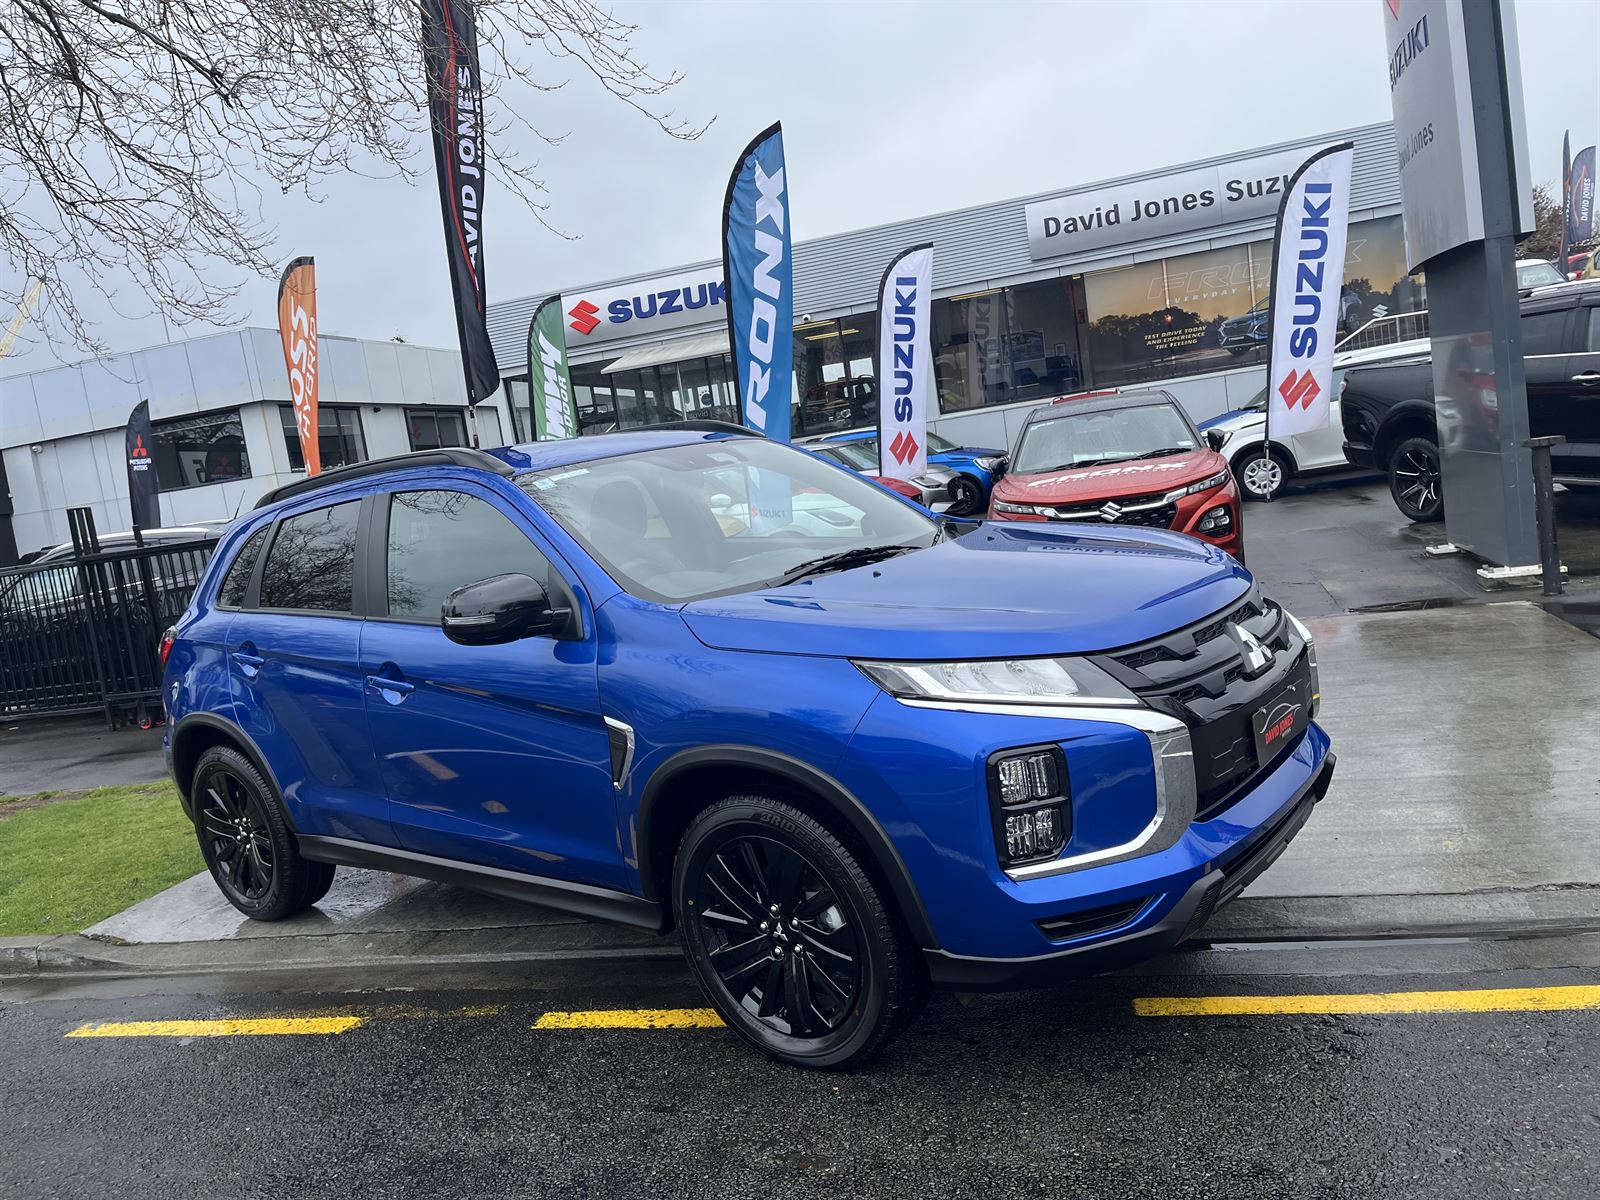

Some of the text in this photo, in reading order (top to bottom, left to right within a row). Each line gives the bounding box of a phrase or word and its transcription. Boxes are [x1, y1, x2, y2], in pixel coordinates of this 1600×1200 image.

[1411, 122, 1434, 158] Jones
[457, 66, 480, 290] AVID JONES
[1580, 177, 1592, 221] DAVID JONES
[1043, 174, 1290, 239] David Jones Suz
[1289, 182, 1333, 359] SUZUKI
[607, 280, 727, 324] SUZUK
[744, 159, 785, 431] RONX
[893, 276, 918, 423] SUZUKI
[1161, 329, 1183, 337] DRIVE
[1184, 325, 1208, 333] TODAY
[1163, 331, 1206, 343] EXPERIENCE
[1170, 339, 1198, 347] FEELING
[302, 316, 316, 438] HYBRID
[1265, 724, 1280, 745] DAVID
[1279, 712, 1294, 736] JONES
